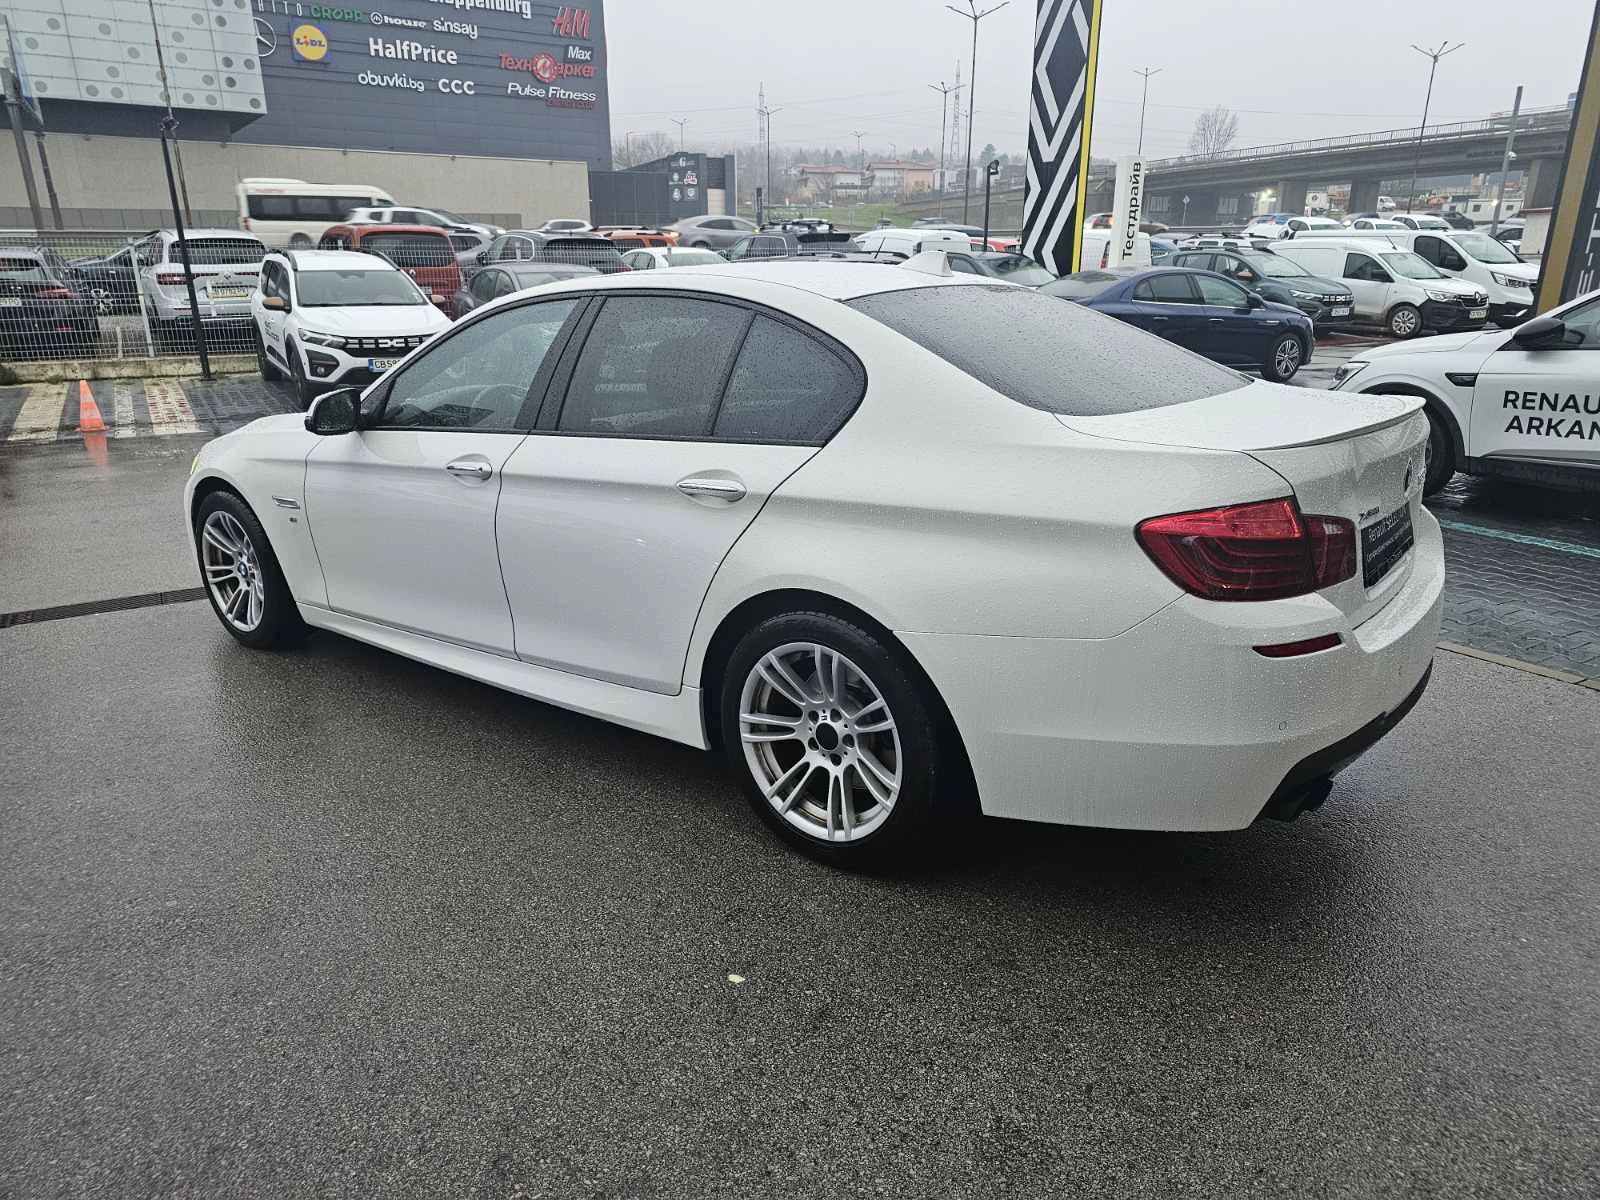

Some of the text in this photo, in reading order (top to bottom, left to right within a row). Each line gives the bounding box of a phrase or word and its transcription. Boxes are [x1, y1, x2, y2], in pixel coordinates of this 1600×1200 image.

[311, 5, 362, 21] CROPP
[429, 0, 532, 19] ppenburg
[433, 17, 478, 39] sinsay
[552, 6, 592, 40] H&M
[368, 37, 458, 65] HalfPrice
[567, 46, 592, 61] Max
[358, 70, 425, 92] obuvki.bg
[507, 82, 597, 102] Pulse Fitness
[1122, 161, 1142, 261] Тестдрайв
[1502, 390, 1600, 415] RENAU
